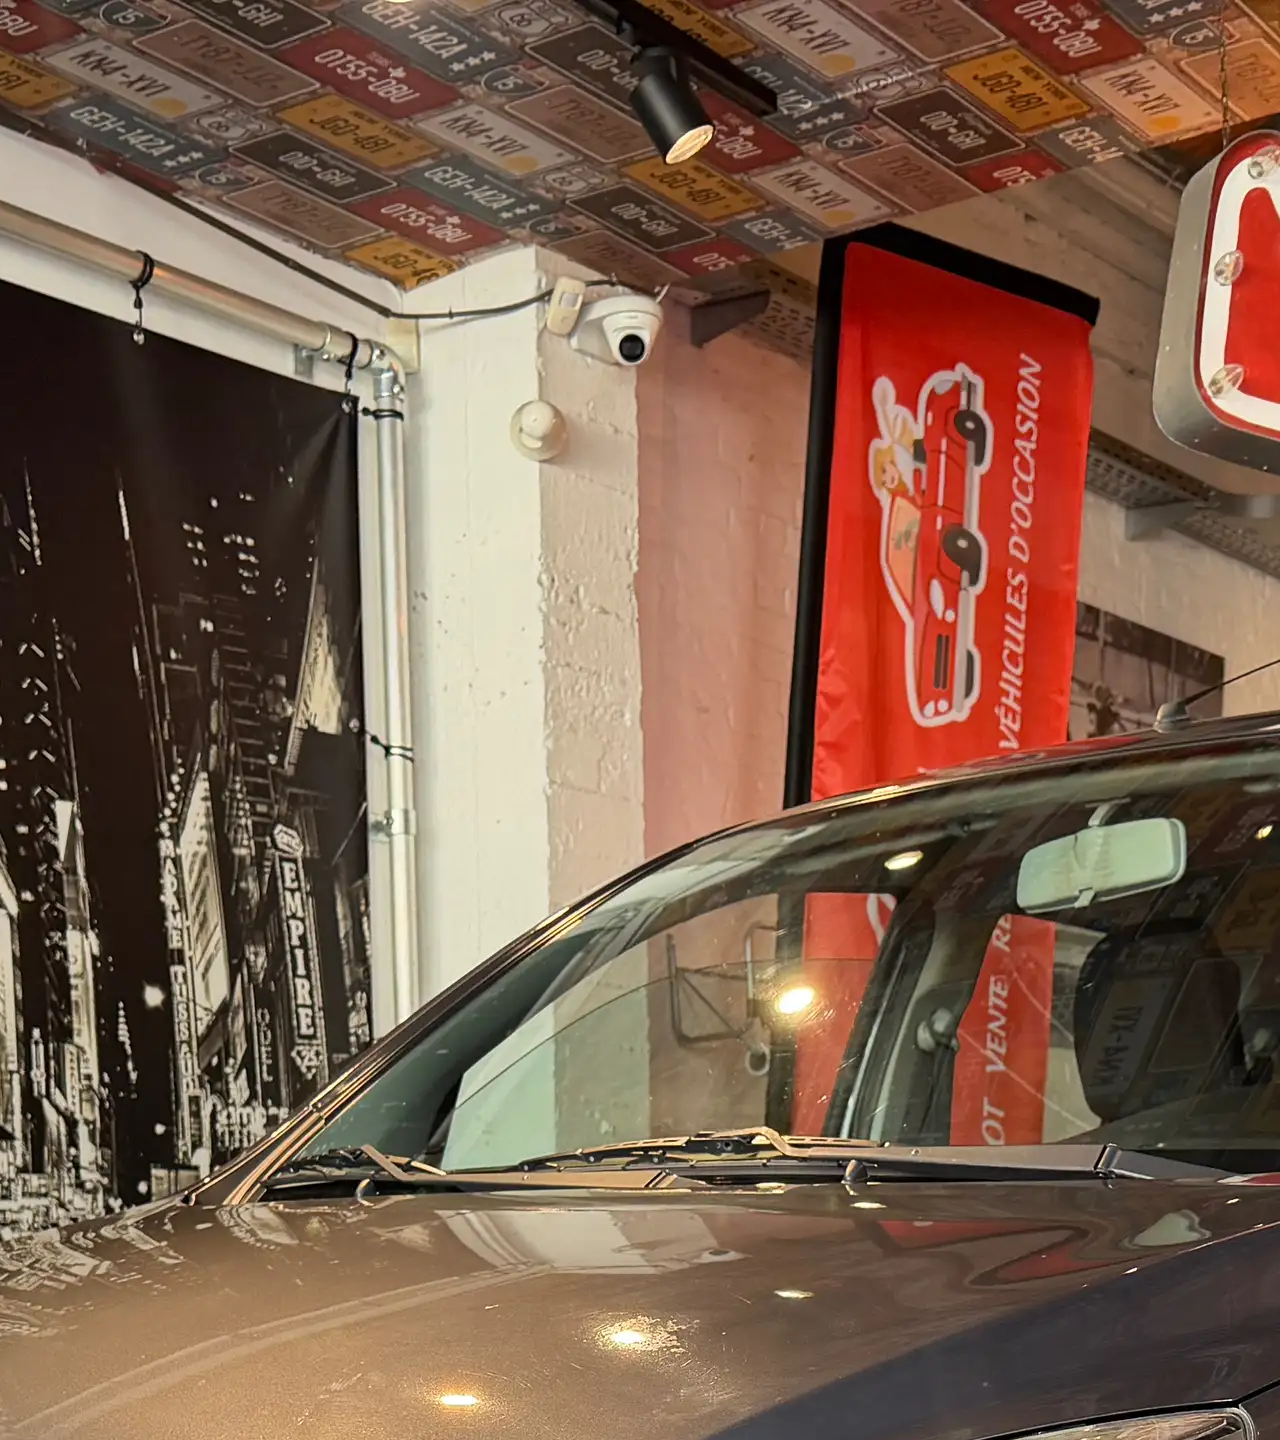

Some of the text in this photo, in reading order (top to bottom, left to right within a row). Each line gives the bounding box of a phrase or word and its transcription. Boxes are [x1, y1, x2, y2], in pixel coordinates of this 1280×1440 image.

[1008, 352, 1044, 563] D'OCCASION
[281, 861, 316, 1038] EMPIRE
[985, 973, 1010, 1074] VENTE
